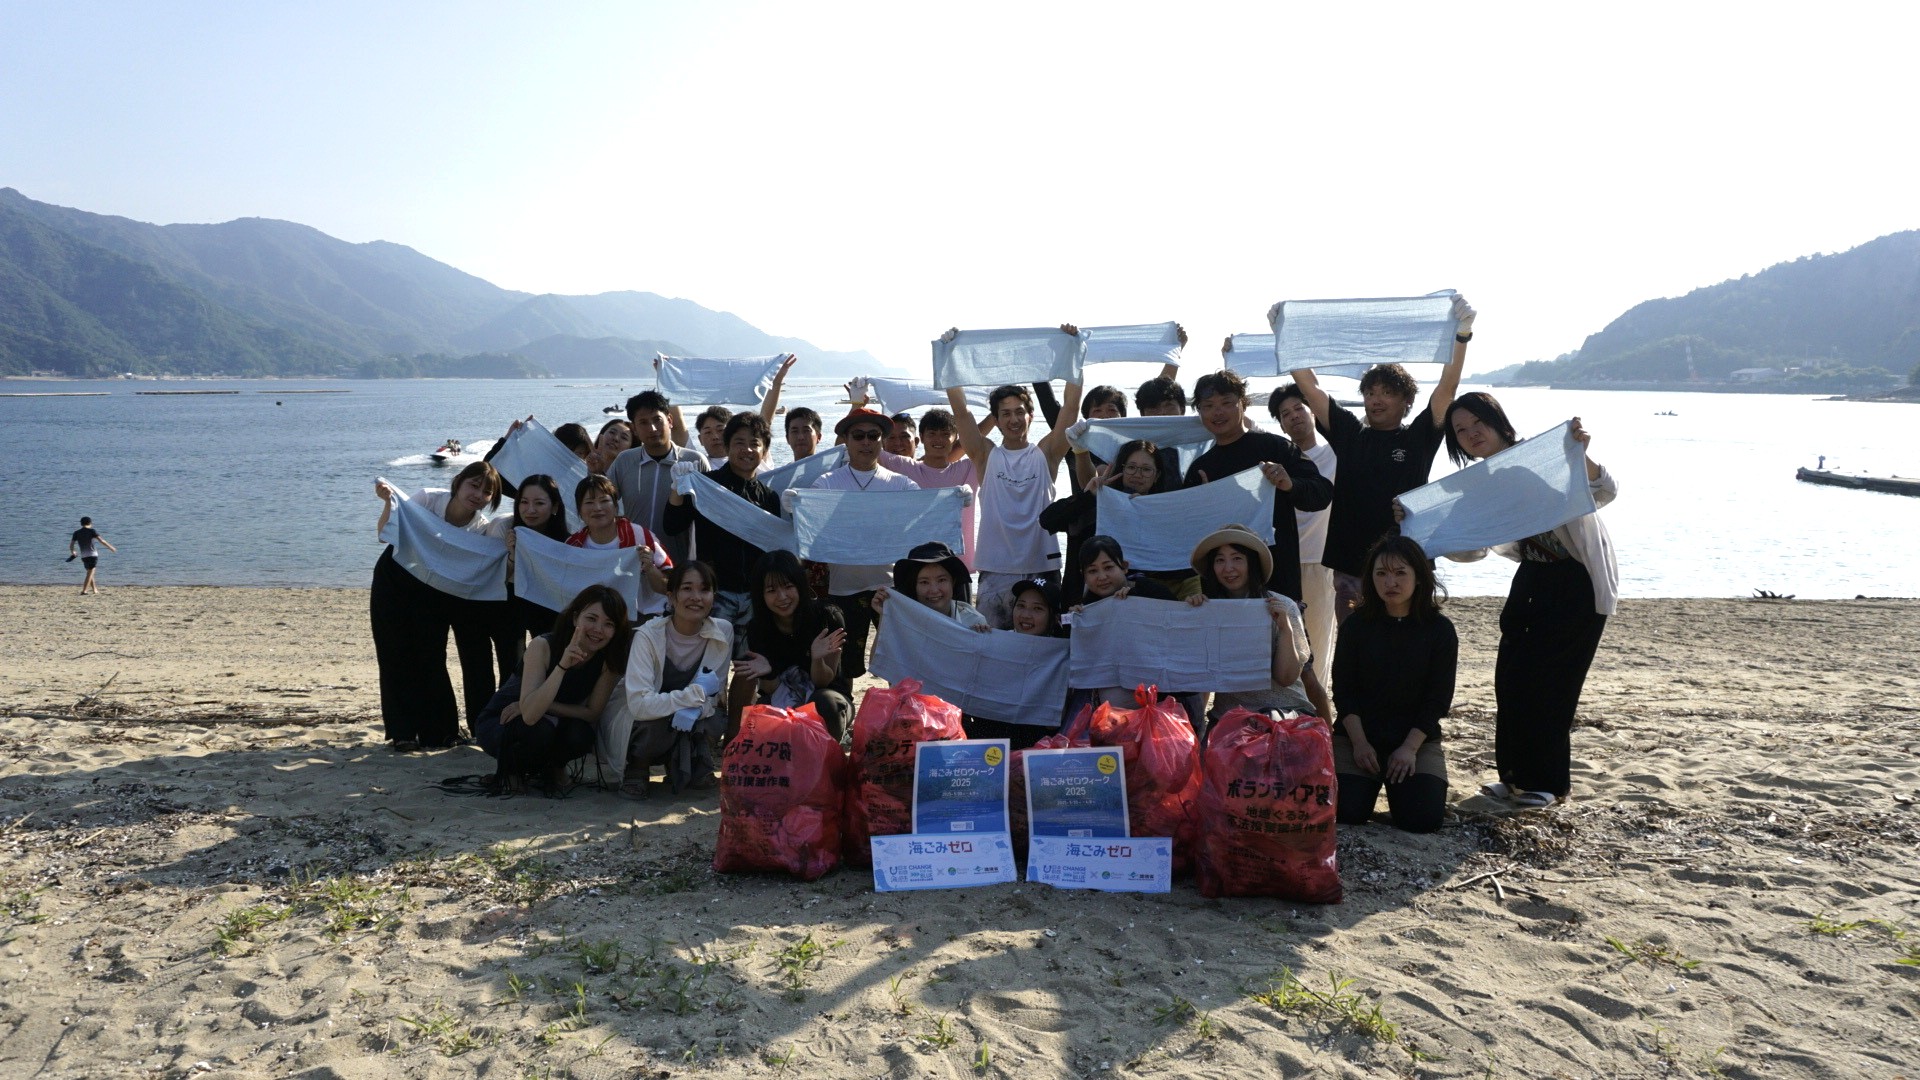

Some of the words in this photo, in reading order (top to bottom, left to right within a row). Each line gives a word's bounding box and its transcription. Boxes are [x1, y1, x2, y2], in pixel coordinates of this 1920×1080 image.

[928, 767, 995, 779] 海ごみゼロウィーク
[951, 778, 971, 788] 2025
[1040, 775, 1110, 787] 海ごみゼロウィーク
[1065, 786, 1087, 796] 2025
[1226, 778, 1331, 806] ボランティア袋
[908, 840, 973, 855] 海ごみゼロ
[1065, 842, 1132, 858] 海ごみゼロ
